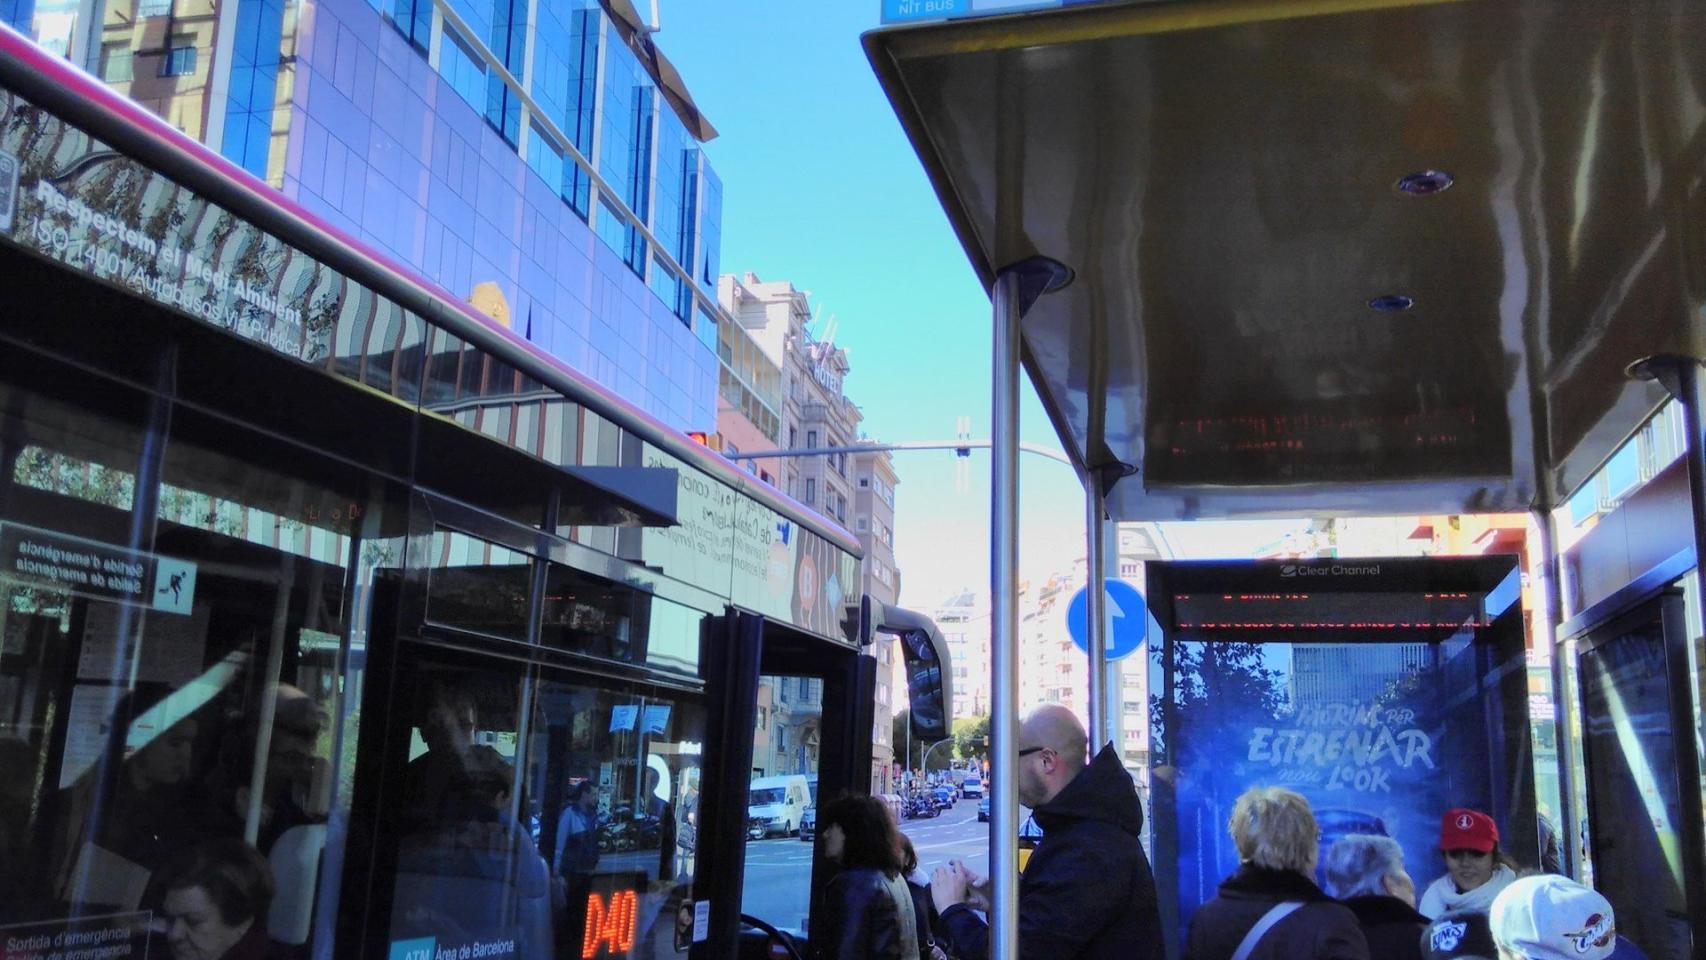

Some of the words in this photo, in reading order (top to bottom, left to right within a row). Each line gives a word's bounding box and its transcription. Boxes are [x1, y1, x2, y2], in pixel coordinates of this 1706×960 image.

[899, 2, 920, 15] NIT
[925, 0, 954, 12] BUS
[37, 180, 157, 256] Respectem
[163, 248, 180, 267] el
[186, 253, 229, 291] Medi
[234, 279, 302, 326] Ambient
[31, 216, 69, 250] ISO
[77, 238, 126, 279] 14001
[133, 266, 220, 320] Autobusos
[225, 306, 249, 335] Via
[814, 364, 839, 395] HOTEL
[1298, 565, 1328, 576] Clear
[1331, 564, 1380, 576] Channel
[581, 889, 638, 959] D40
[6, 935, 51, 952] Sortida
[458, 945, 471, 960] de
[472, 939, 514, 958] Barcelona
